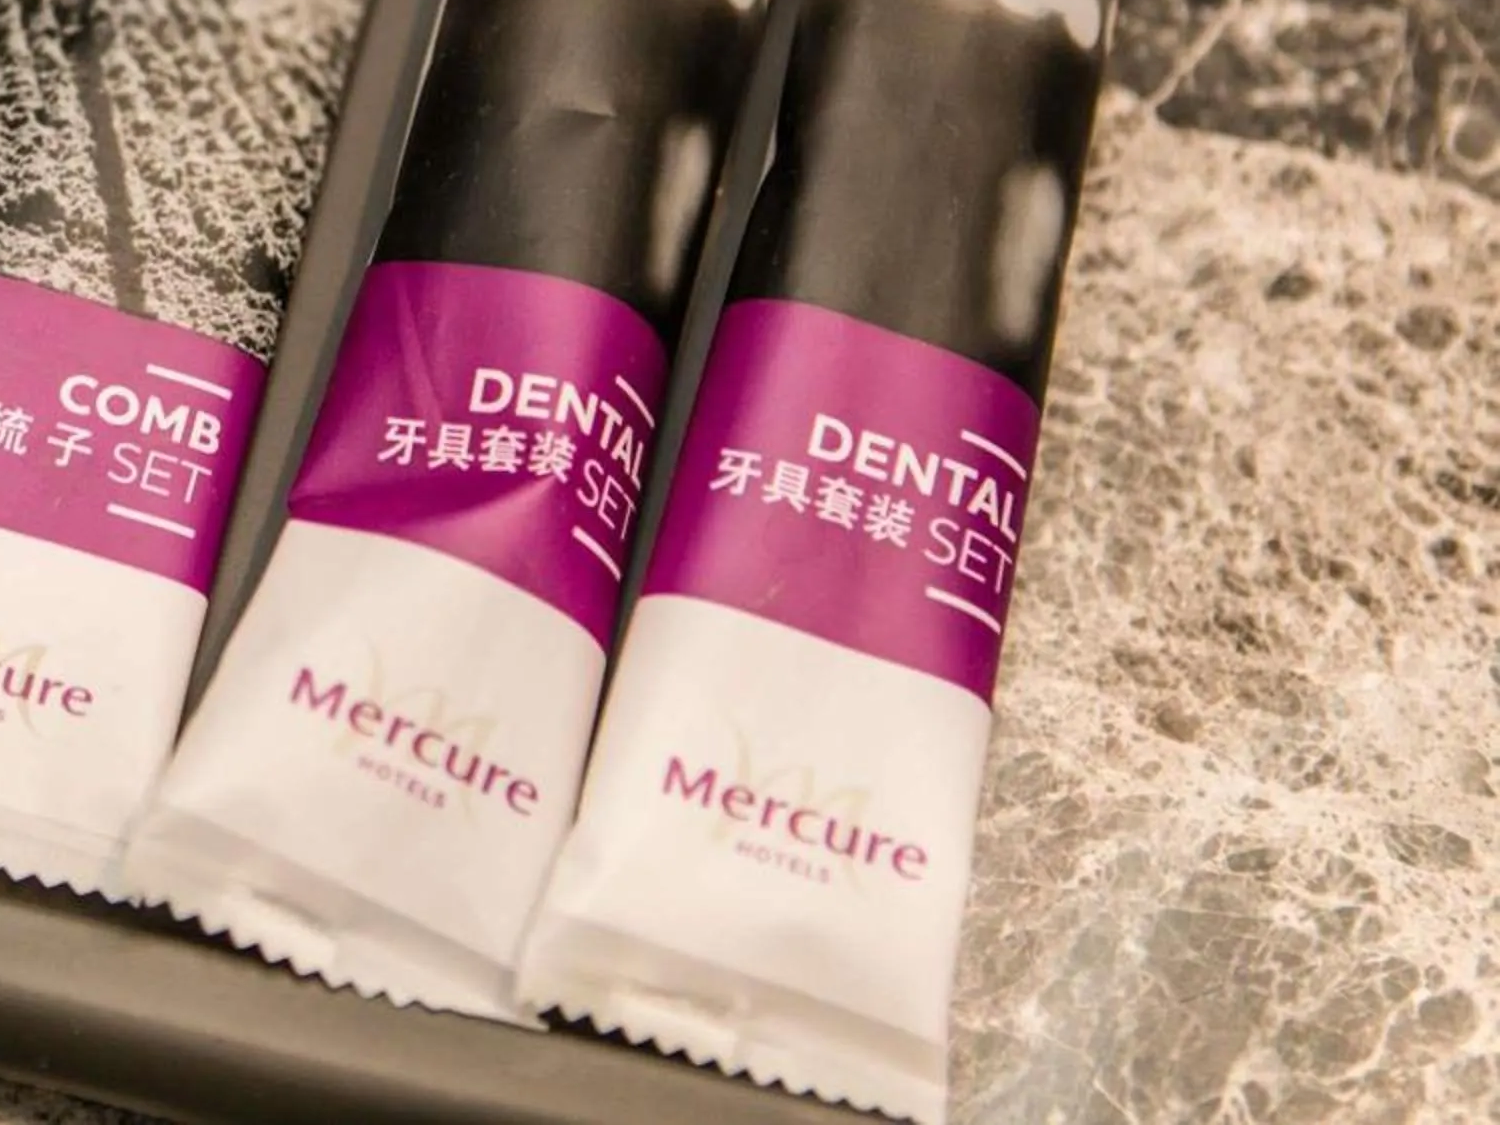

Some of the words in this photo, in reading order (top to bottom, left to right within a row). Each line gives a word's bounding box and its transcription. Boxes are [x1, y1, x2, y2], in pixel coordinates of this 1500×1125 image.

[59, 374, 222, 455] COMB
[106, 442, 213, 505] SET
[468, 367, 644, 491] DENTAL
[376, 416, 577, 484] 牙具套装
[576, 459, 636, 541] SET
[708, 447, 916, 549] 牙具套装
[923, 516, 1013, 595] SET
[807, 413, 1017, 544] DENTAL
[289, 666, 541, 816] Mercure
[356, 754, 449, 810] HOTELS
[661, 755, 930, 881] Mercure
[734, 839, 832, 885] HOTELS
